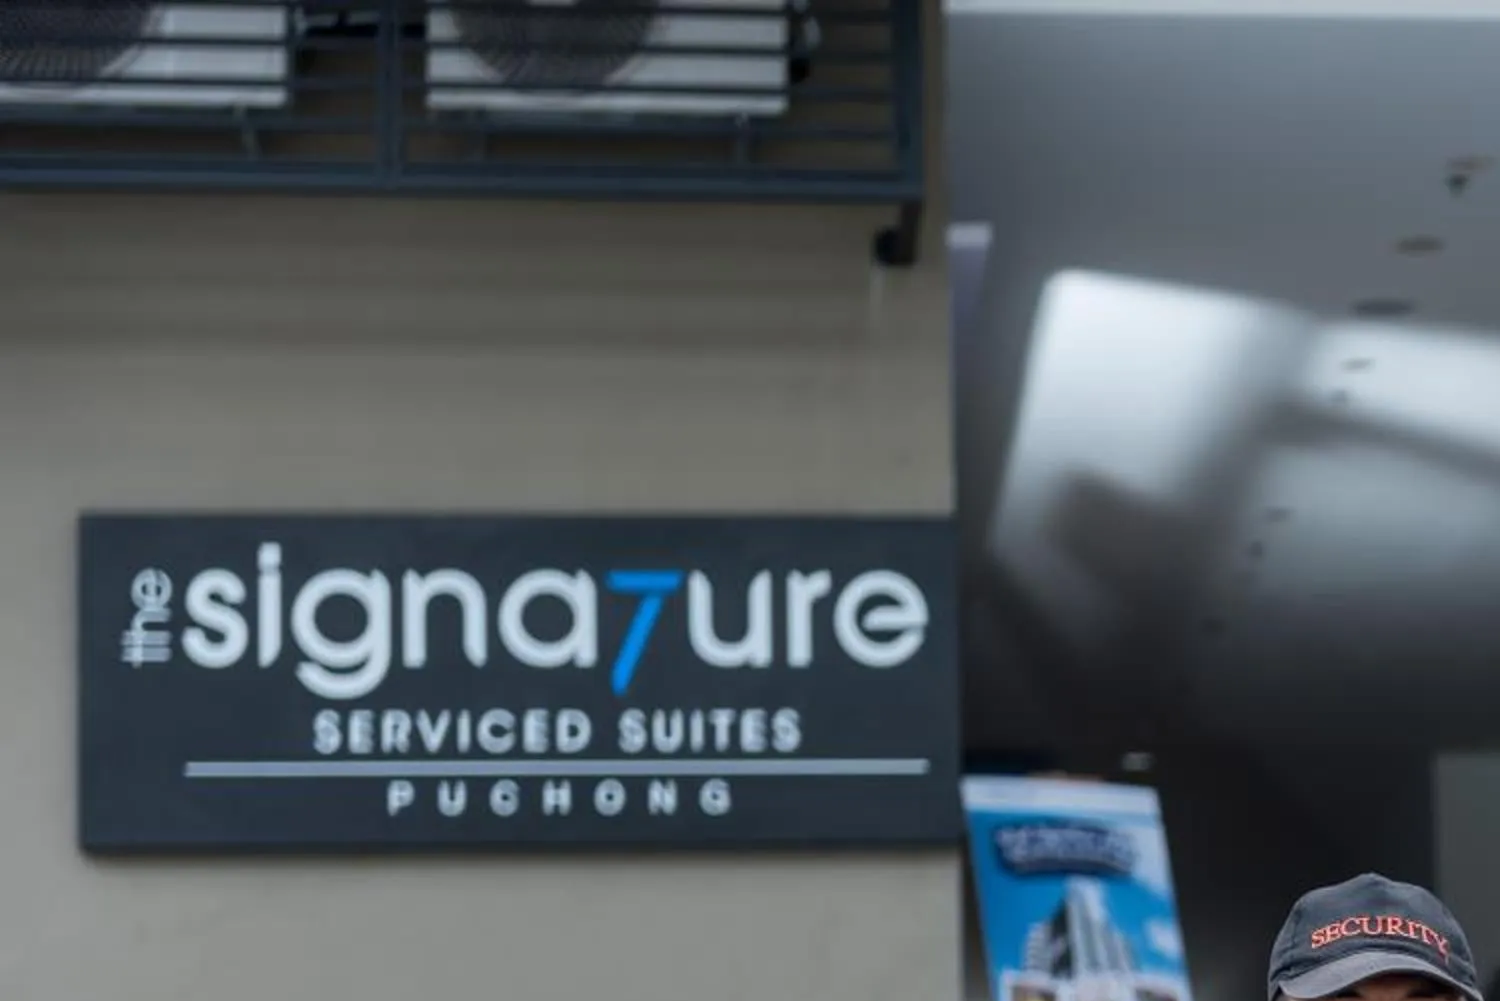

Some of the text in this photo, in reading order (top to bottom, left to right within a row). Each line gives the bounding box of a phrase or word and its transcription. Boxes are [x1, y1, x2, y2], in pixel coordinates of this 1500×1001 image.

[121, 567, 171, 666] the
[313, 709, 803, 754] SERVICED SUITES
[387, 780, 733, 817] PUCHONG
[1310, 913, 1450, 962] SECURITY
